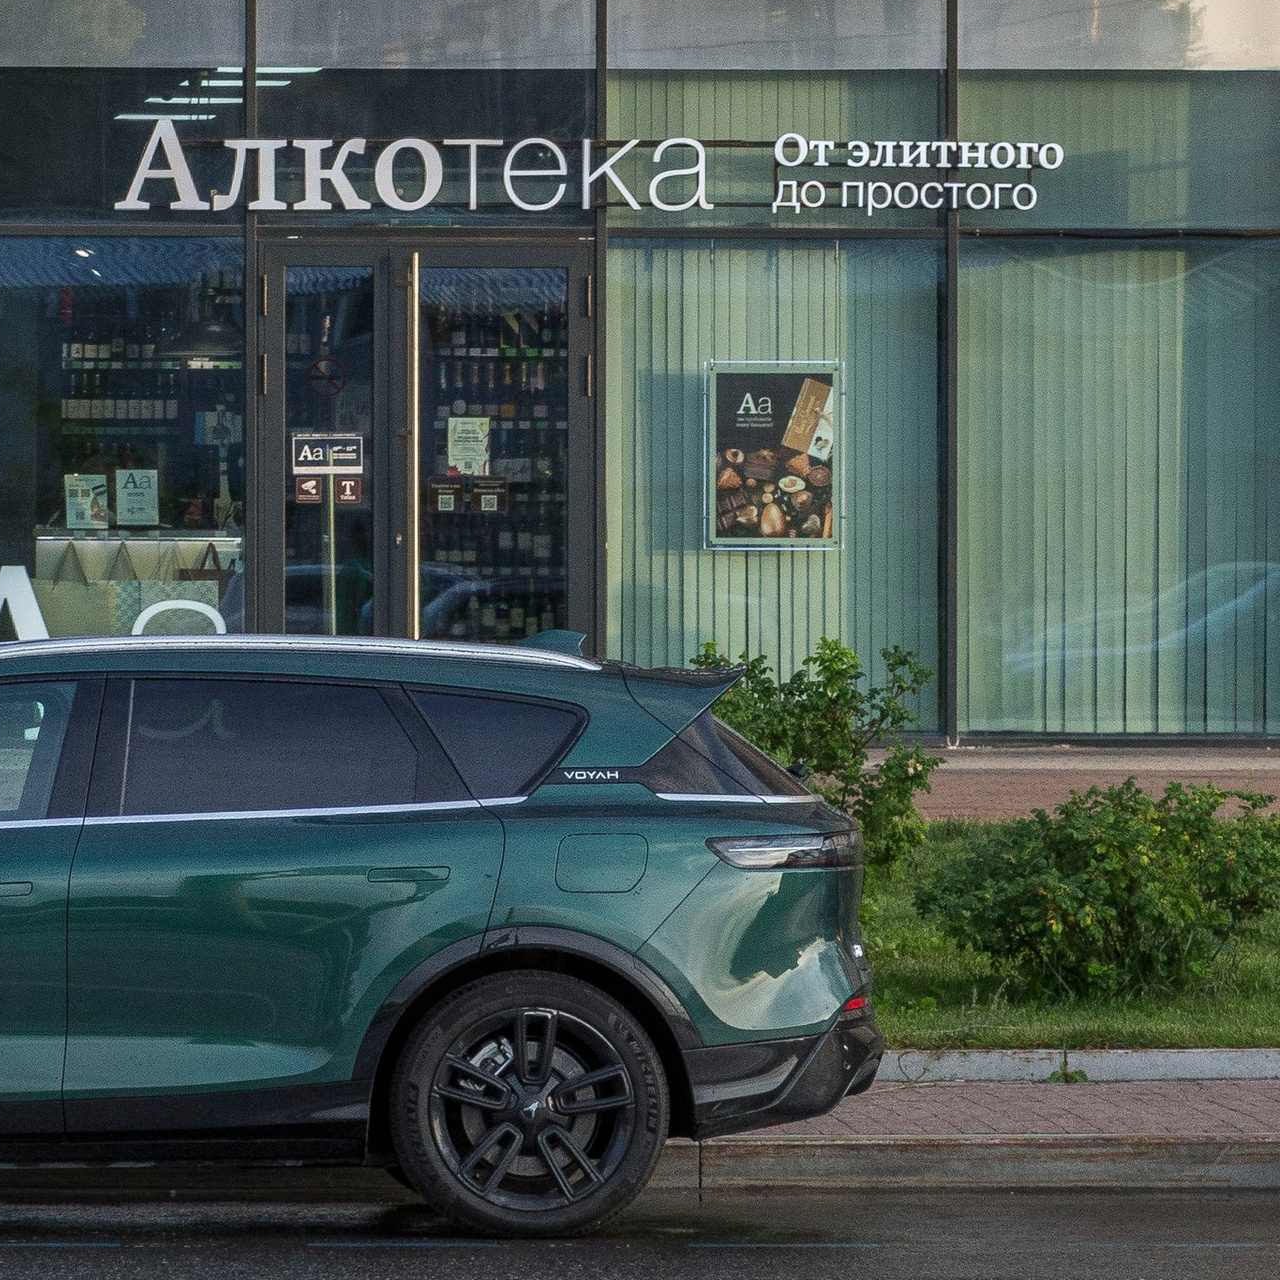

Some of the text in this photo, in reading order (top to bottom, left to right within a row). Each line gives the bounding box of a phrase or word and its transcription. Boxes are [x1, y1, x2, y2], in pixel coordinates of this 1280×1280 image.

[113, 119, 714, 211] Алкотека
[774, 132, 1064, 169] От элитного
[772, 180, 1038, 216] до простого
